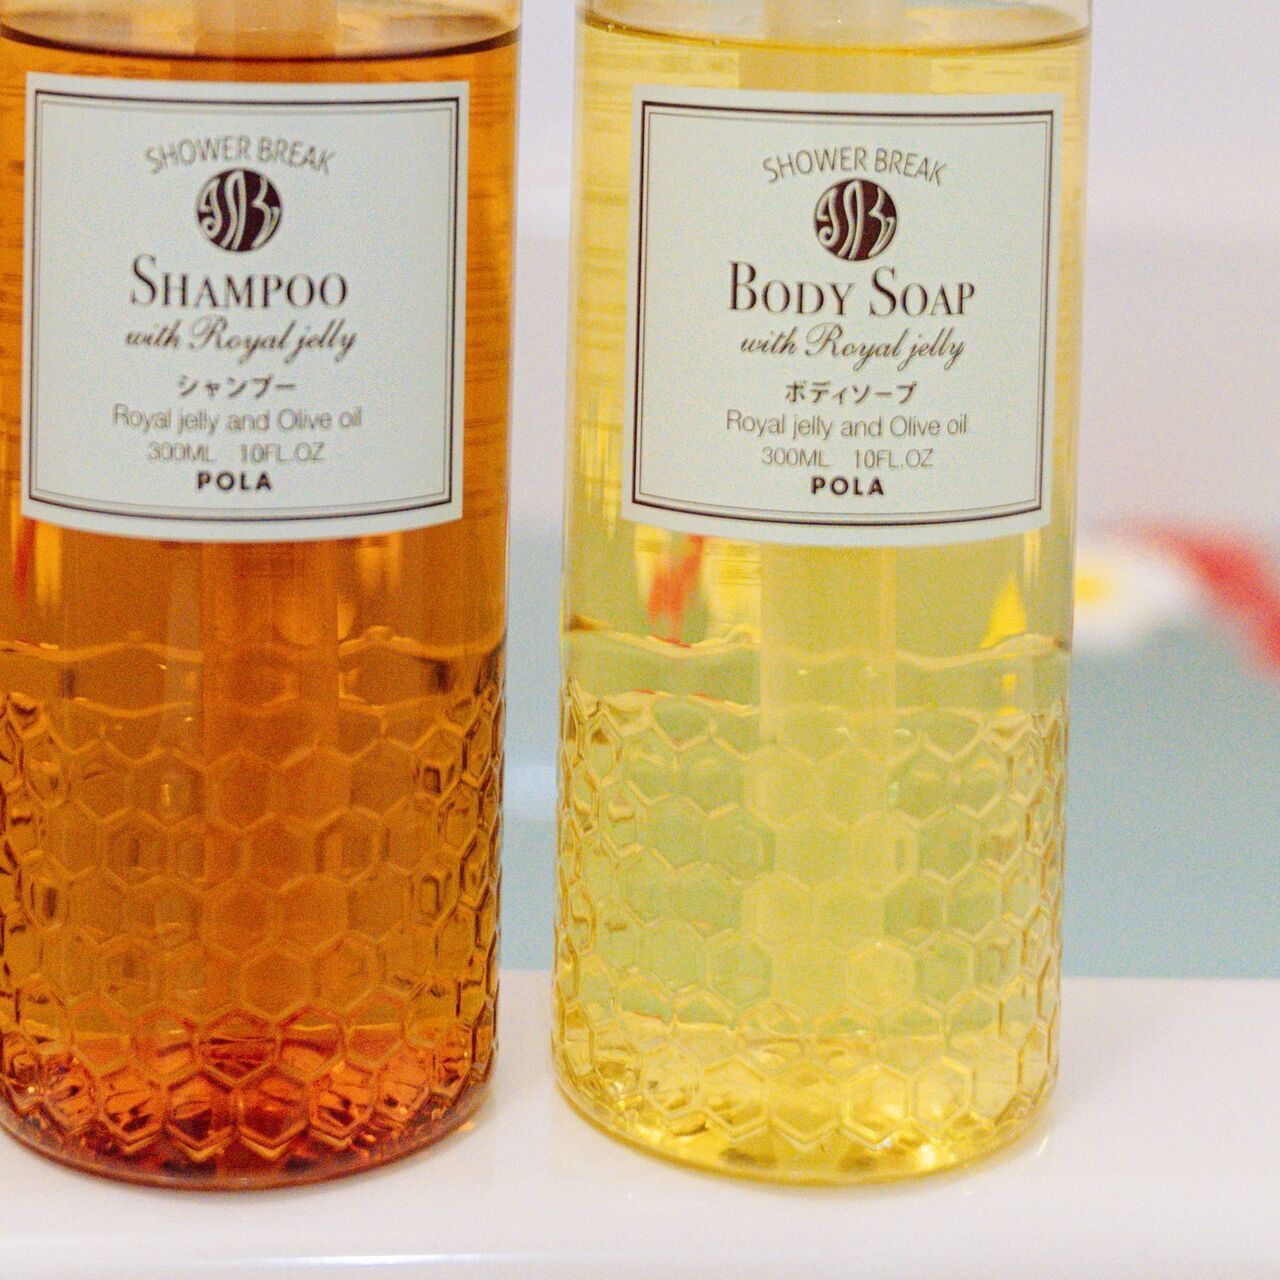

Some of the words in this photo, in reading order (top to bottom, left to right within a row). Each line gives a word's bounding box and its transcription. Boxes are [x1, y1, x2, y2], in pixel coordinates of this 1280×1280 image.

[144, 135, 250, 175] SHOWER
[258, 137, 336, 176] BREAK
[762, 147, 868, 184] SHOWER
[874, 148, 948, 187] BREAK
[130, 252, 348, 310] SHAMPOO
[727, 261, 857, 315] BODY
[868, 266, 976, 317] SOAP
[124, 320, 182, 351] with
[189, 315, 297, 364] Royal
[285, 318, 358, 365] jelly
[740, 328, 797, 356] with
[805, 322, 905, 372] Royal
[896, 326, 966, 371] jelly
[177, 375, 298, 399] シャンプー
[785, 381, 917, 405] ボディソープ
[112, 403, 172, 431] Royal
[176, 408, 218, 435] jelly
[226, 409, 271, 432] and
[276, 408, 333, 431] Olive
[339, 406, 362, 429] oil
[726, 409, 784, 437] Royal
[792, 414, 833, 440] jelly
[840, 415, 882, 437] and
[889, 415, 941, 437] Olive
[946, 412, 968, 435] oil
[148, 441, 215, 464] 300ML
[761, 448, 830, 468] 300ML
[198, 472, 272, 492] POLA
[810, 476, 885, 496] POLA
